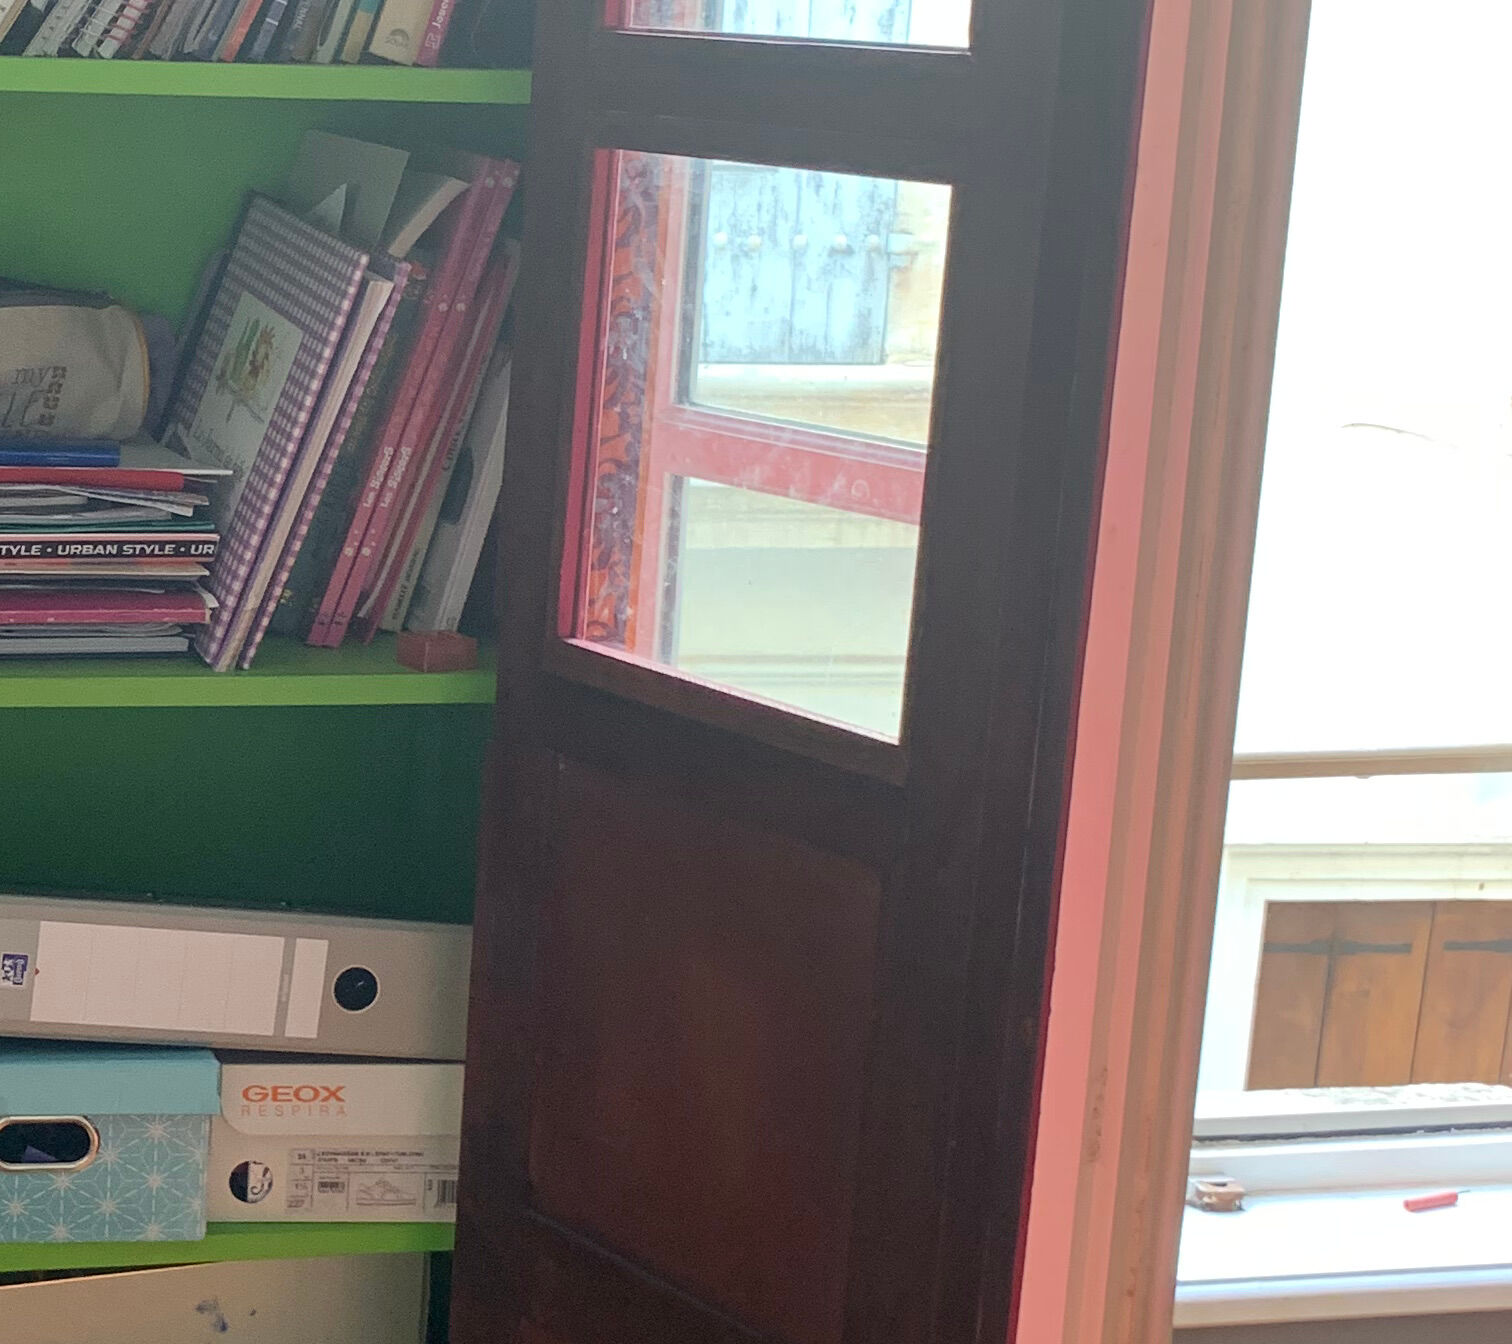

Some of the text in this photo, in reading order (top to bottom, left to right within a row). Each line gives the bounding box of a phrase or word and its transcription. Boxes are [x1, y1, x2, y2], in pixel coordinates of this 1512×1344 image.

[56, 544, 119, 555] URBAN
[122, 544, 176, 555] STYLE
[189, 544, 216, 555] UR
[242, 1084, 347, 1103] GEOX
[241, 1105, 348, 1117] RESPIRA
